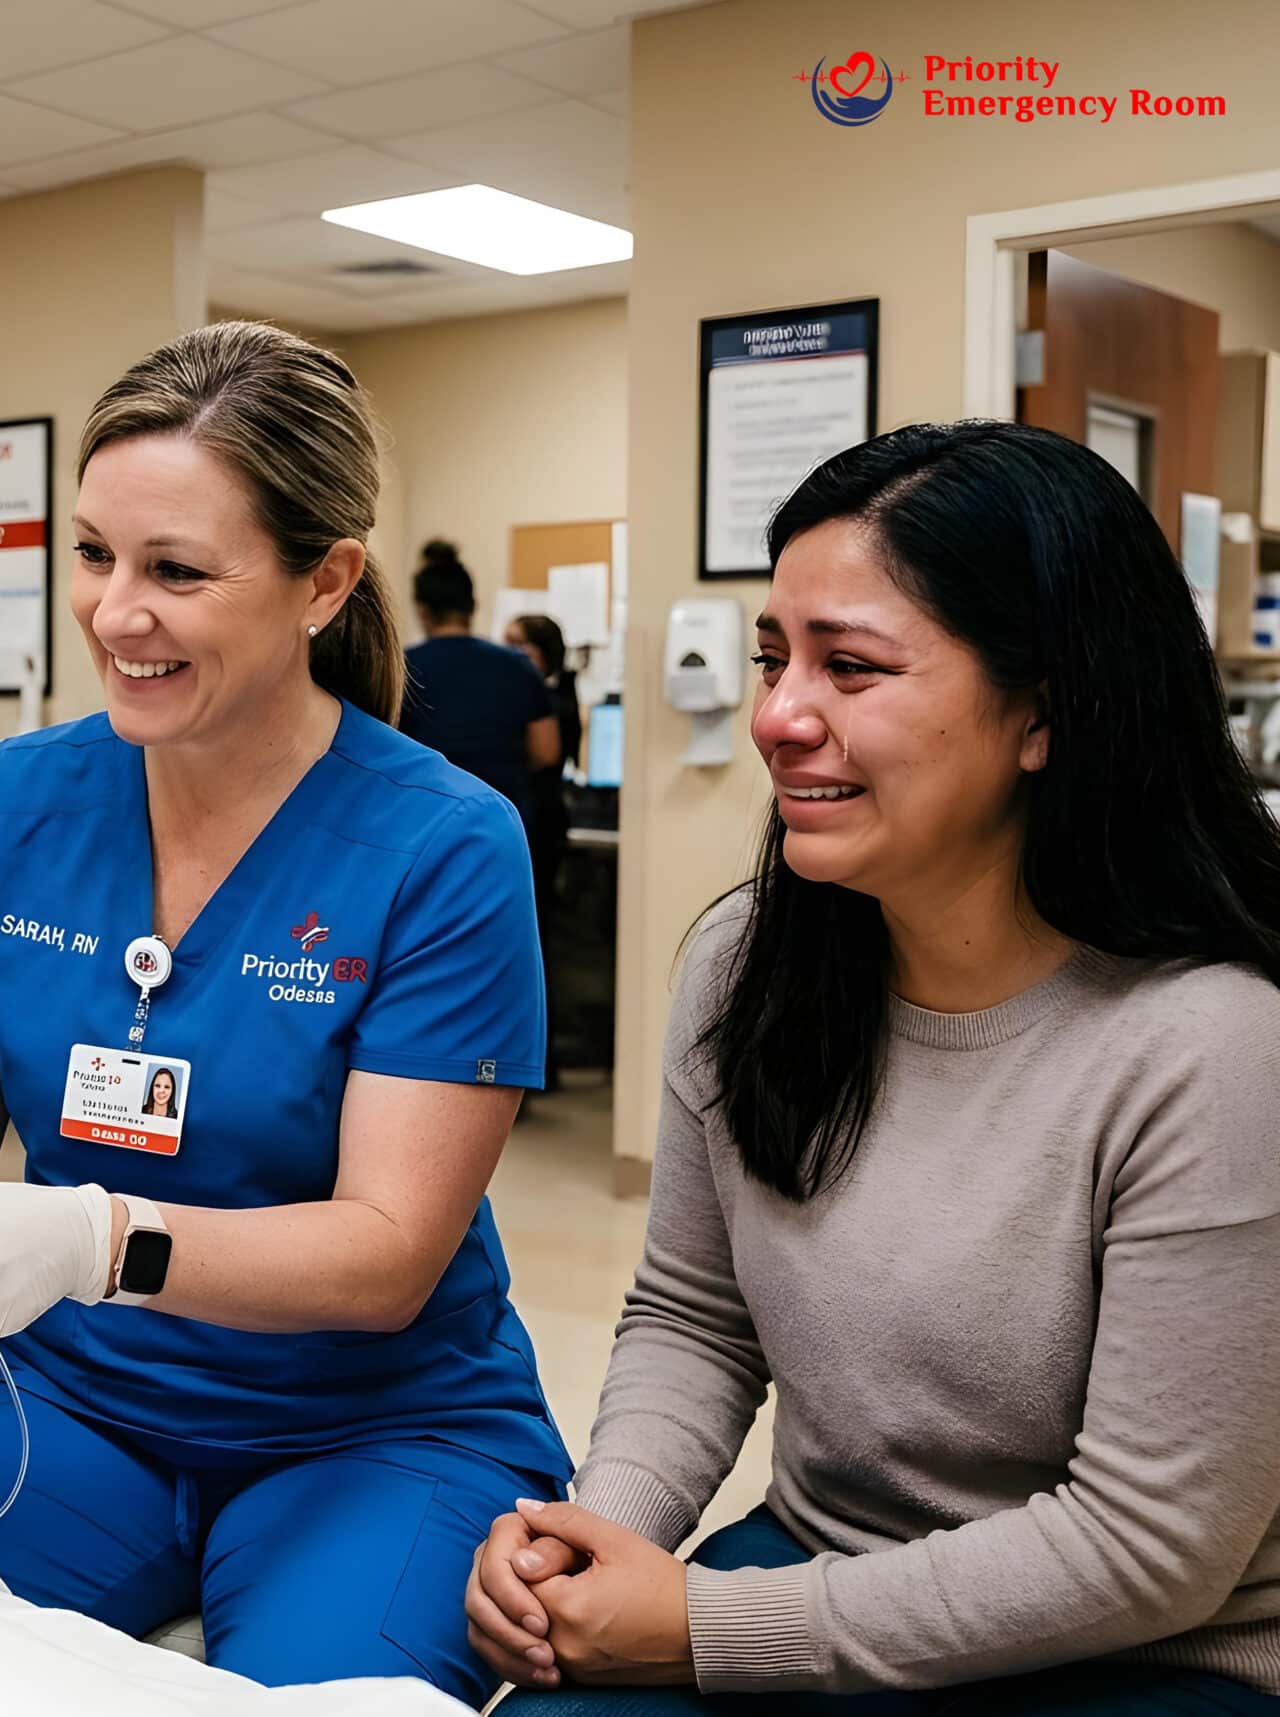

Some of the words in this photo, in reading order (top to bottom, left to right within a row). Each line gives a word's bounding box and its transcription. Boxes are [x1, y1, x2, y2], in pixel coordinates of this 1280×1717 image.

[0, 914, 65, 952] SARAH,
[71, 933, 100, 956] RN
[241, 954, 329, 987] Priority
